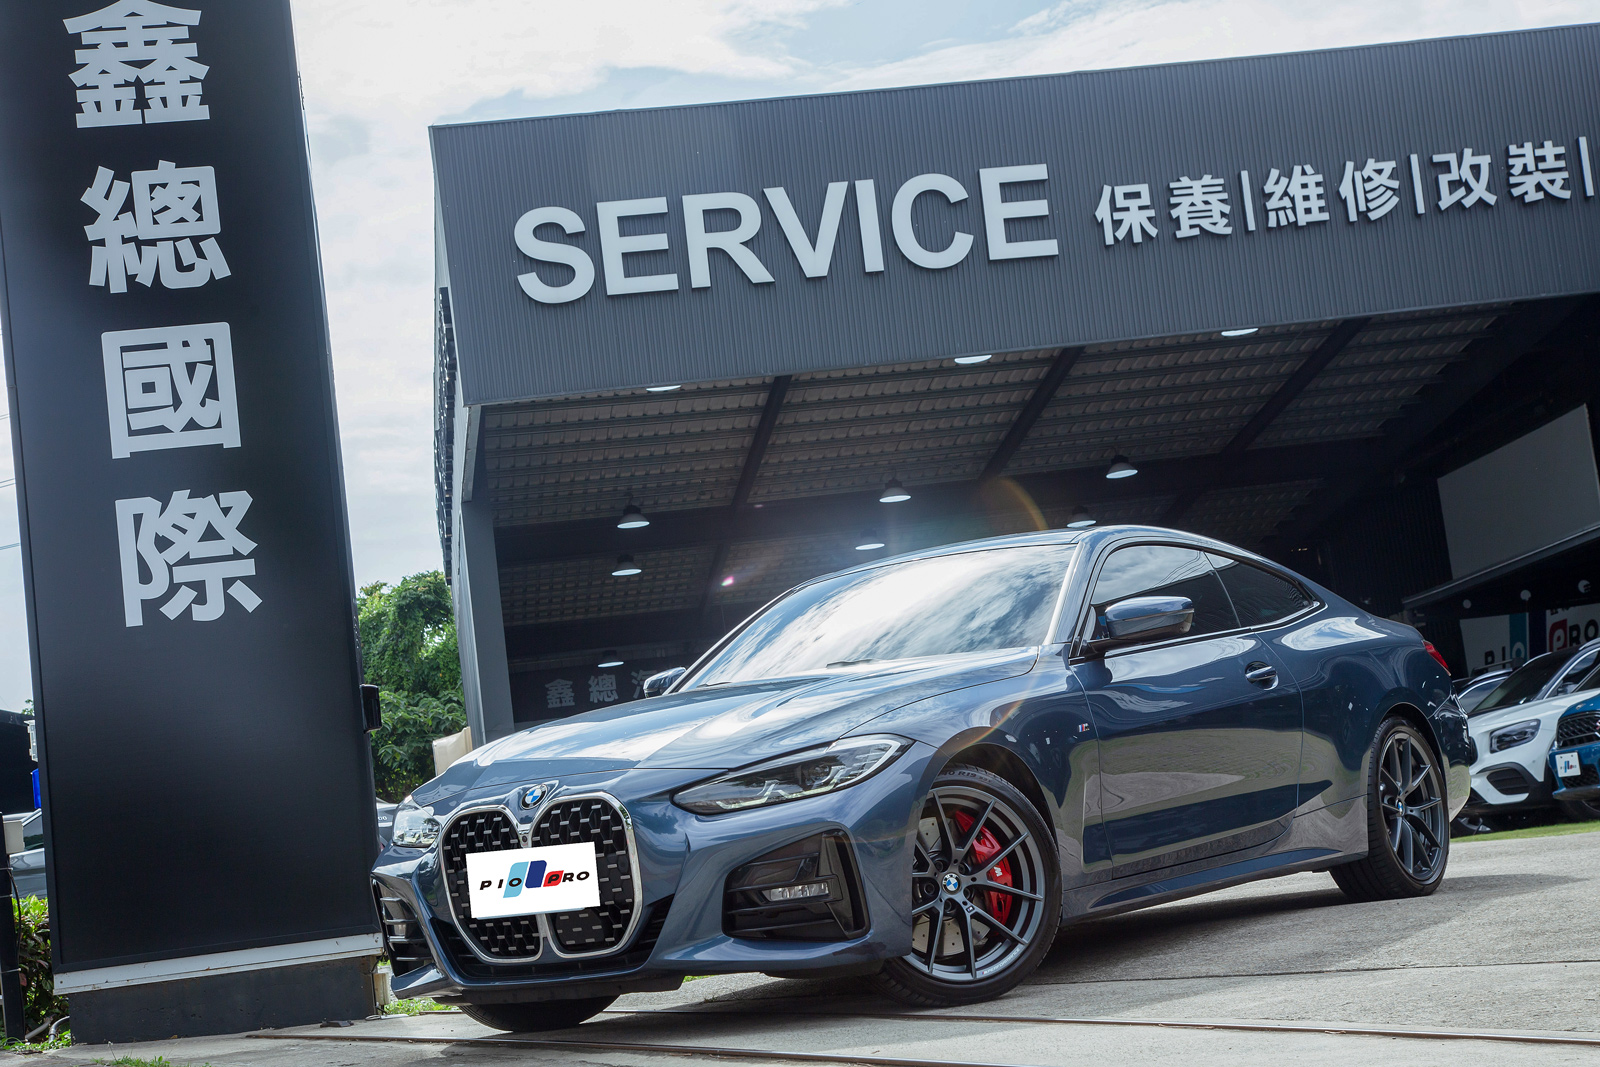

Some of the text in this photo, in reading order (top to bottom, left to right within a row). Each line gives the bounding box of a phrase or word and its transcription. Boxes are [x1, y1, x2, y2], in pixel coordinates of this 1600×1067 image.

[513, 163, 1060, 305] SERVICE
[62, 0, 263, 628] 鑫總國際
[479, 871, 590, 891] PIO PRO
